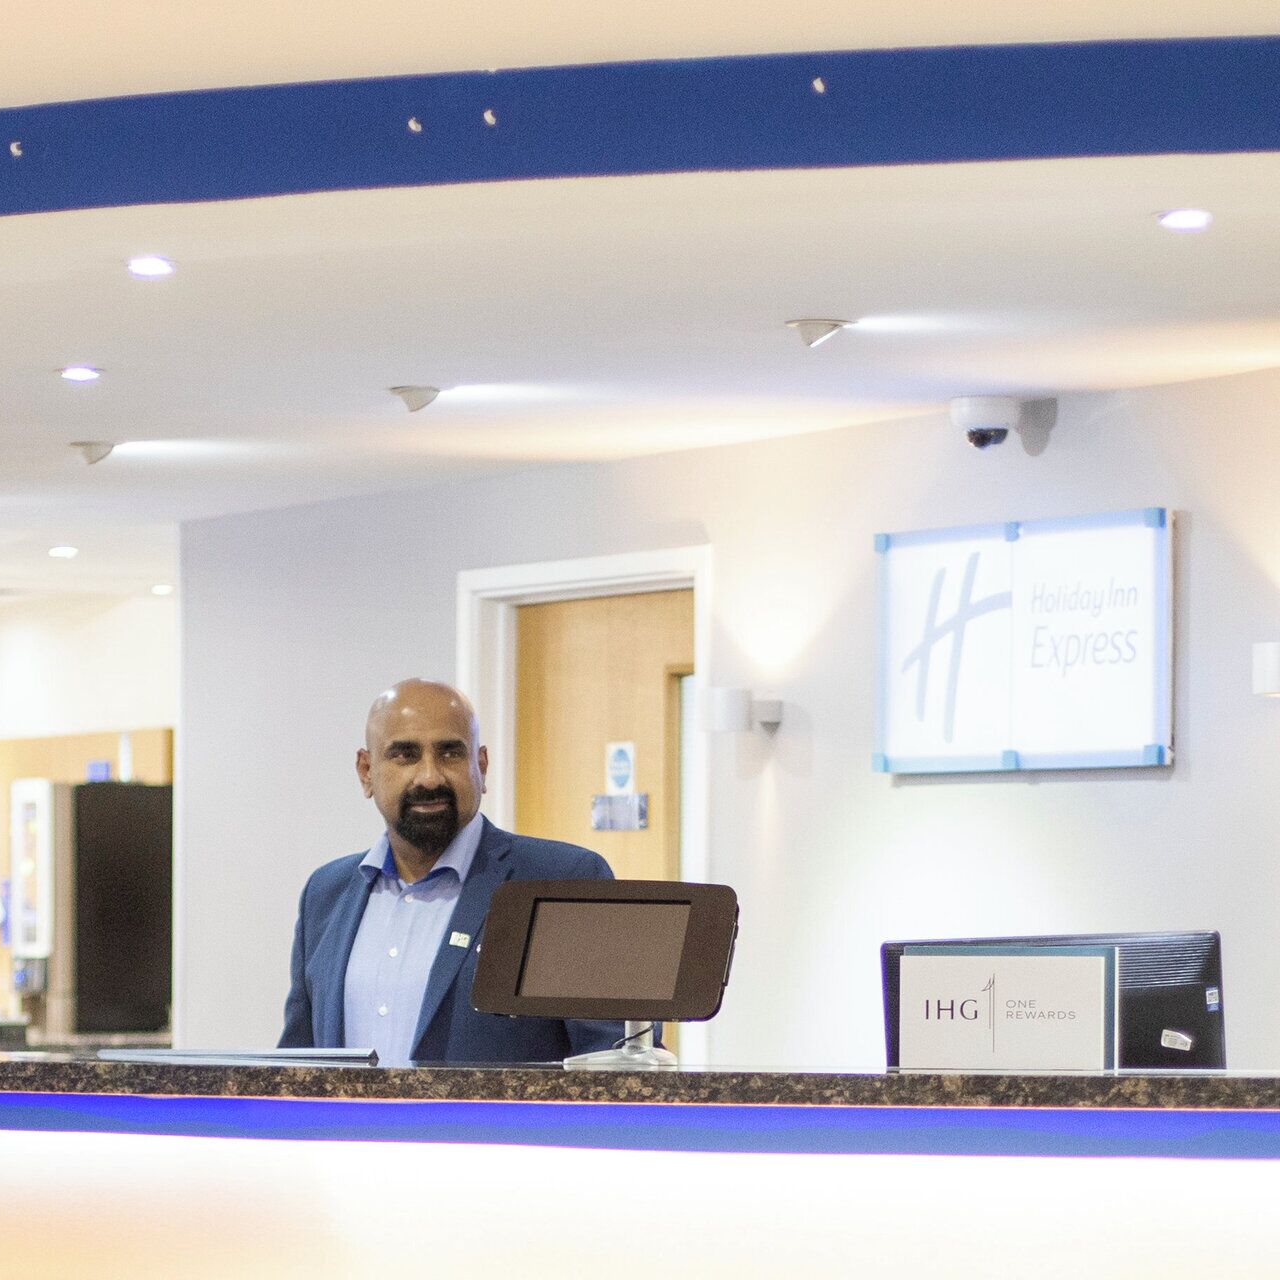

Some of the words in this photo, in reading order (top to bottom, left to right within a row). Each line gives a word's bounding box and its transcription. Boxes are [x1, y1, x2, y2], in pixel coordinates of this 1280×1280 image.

[1031, 579, 1105, 618] Holiday
[1107, 577, 1139, 609] Inn
[1031, 625, 1138, 678] Express
[924, 999, 978, 1020] IHG
[1005, 999, 1036, 1009] ONE
[1005, 1010, 1076, 1020] REWARDS
